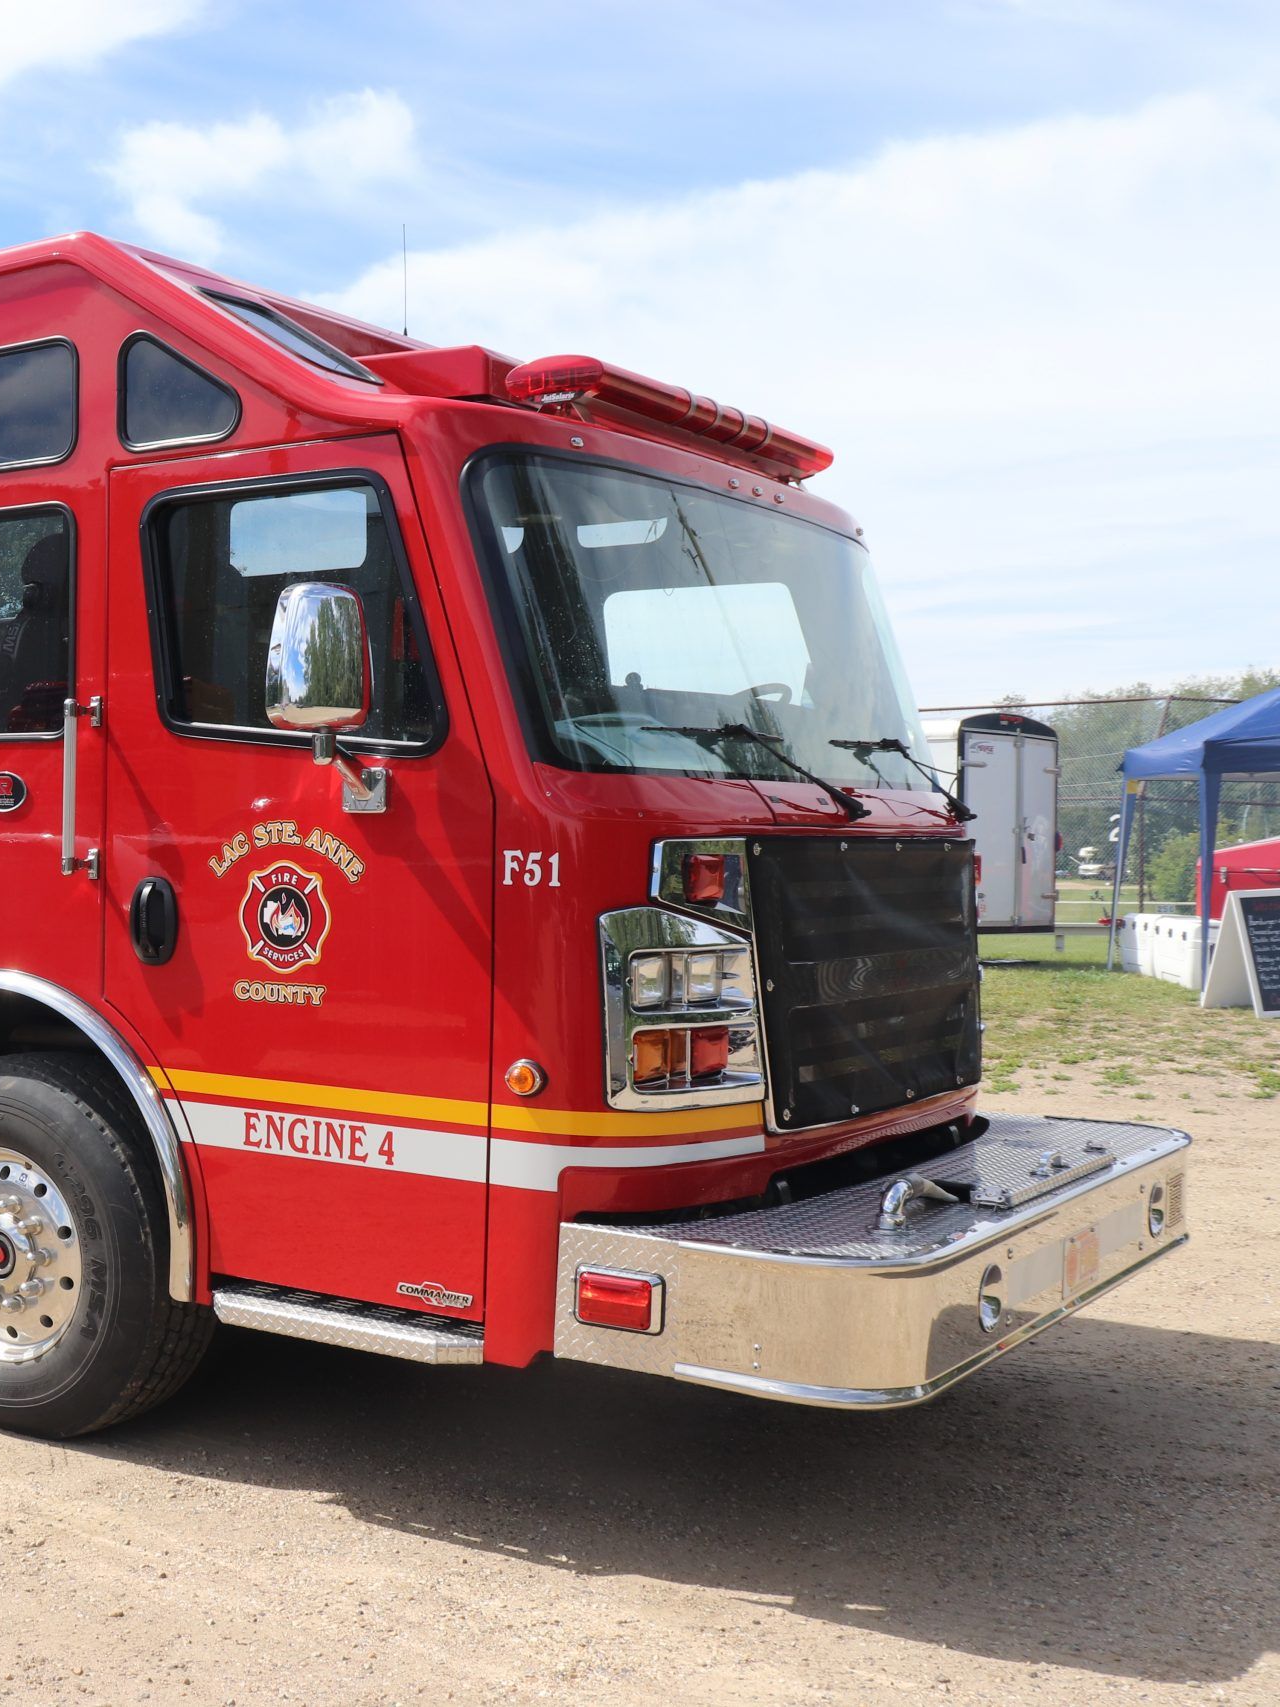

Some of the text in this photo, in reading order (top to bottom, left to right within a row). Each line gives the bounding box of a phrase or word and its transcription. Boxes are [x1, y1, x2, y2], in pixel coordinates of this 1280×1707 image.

[209, 821, 364, 882] LAC STE. ANNE
[272, 872, 298, 885] FIRE
[502, 850, 561, 887] F51
[263, 947, 304, 962] SERVICES
[234, 981, 325, 1005] COUNTY
[243, 1112, 395, 1165] ENGINE 4
[399, 1284, 469, 1304] COMMANDER
